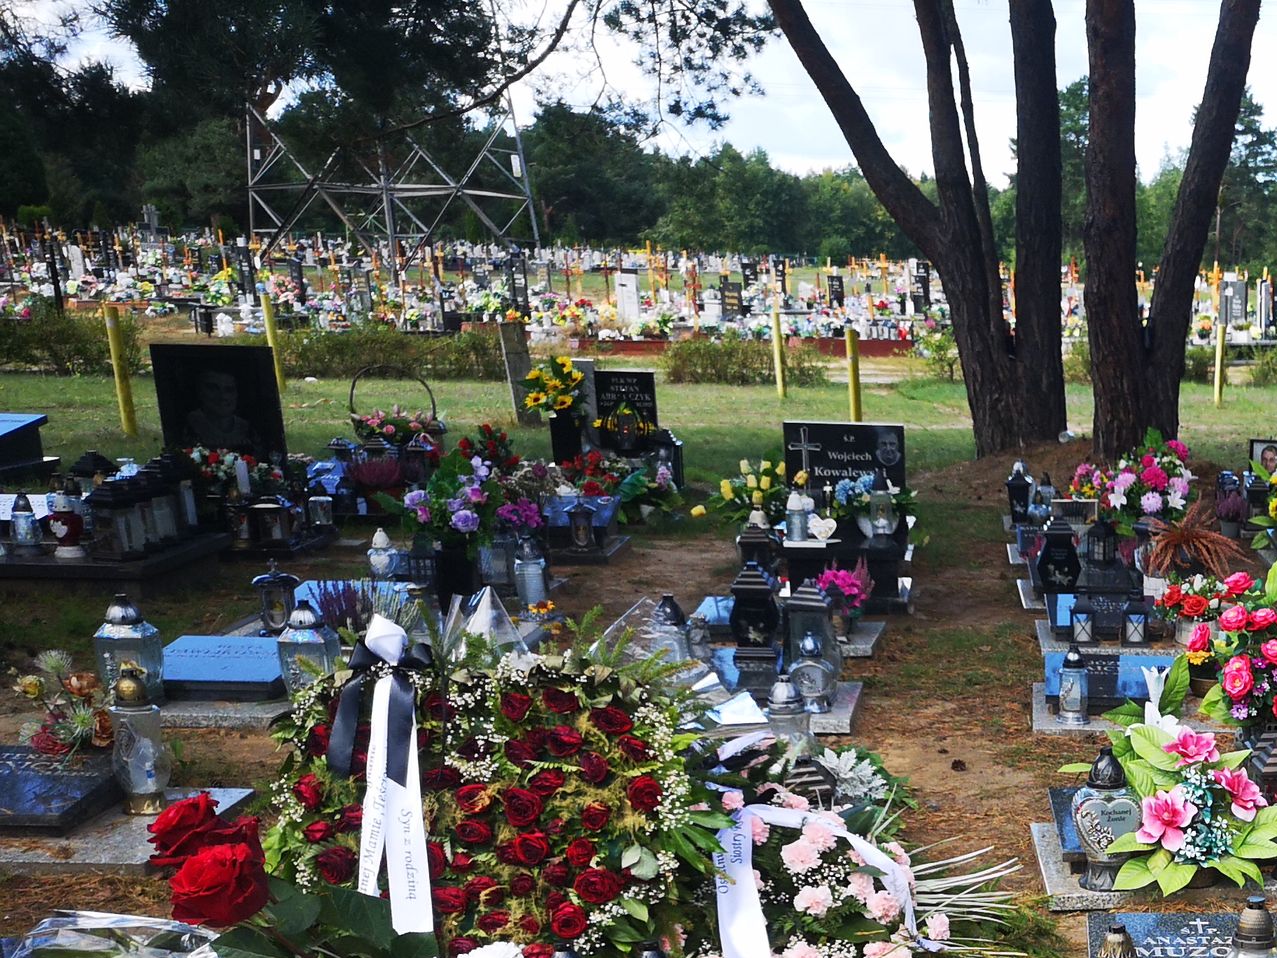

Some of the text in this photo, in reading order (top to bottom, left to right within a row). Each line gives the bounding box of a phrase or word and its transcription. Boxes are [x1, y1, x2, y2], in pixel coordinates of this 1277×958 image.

[827, 451, 872, 462] Wojciech
[814, 466, 888, 478] Kowalewsi
[401, 808, 413, 834] Syn
[362, 819, 383, 866] Mamie
[730, 833, 746, 864] Siostry
